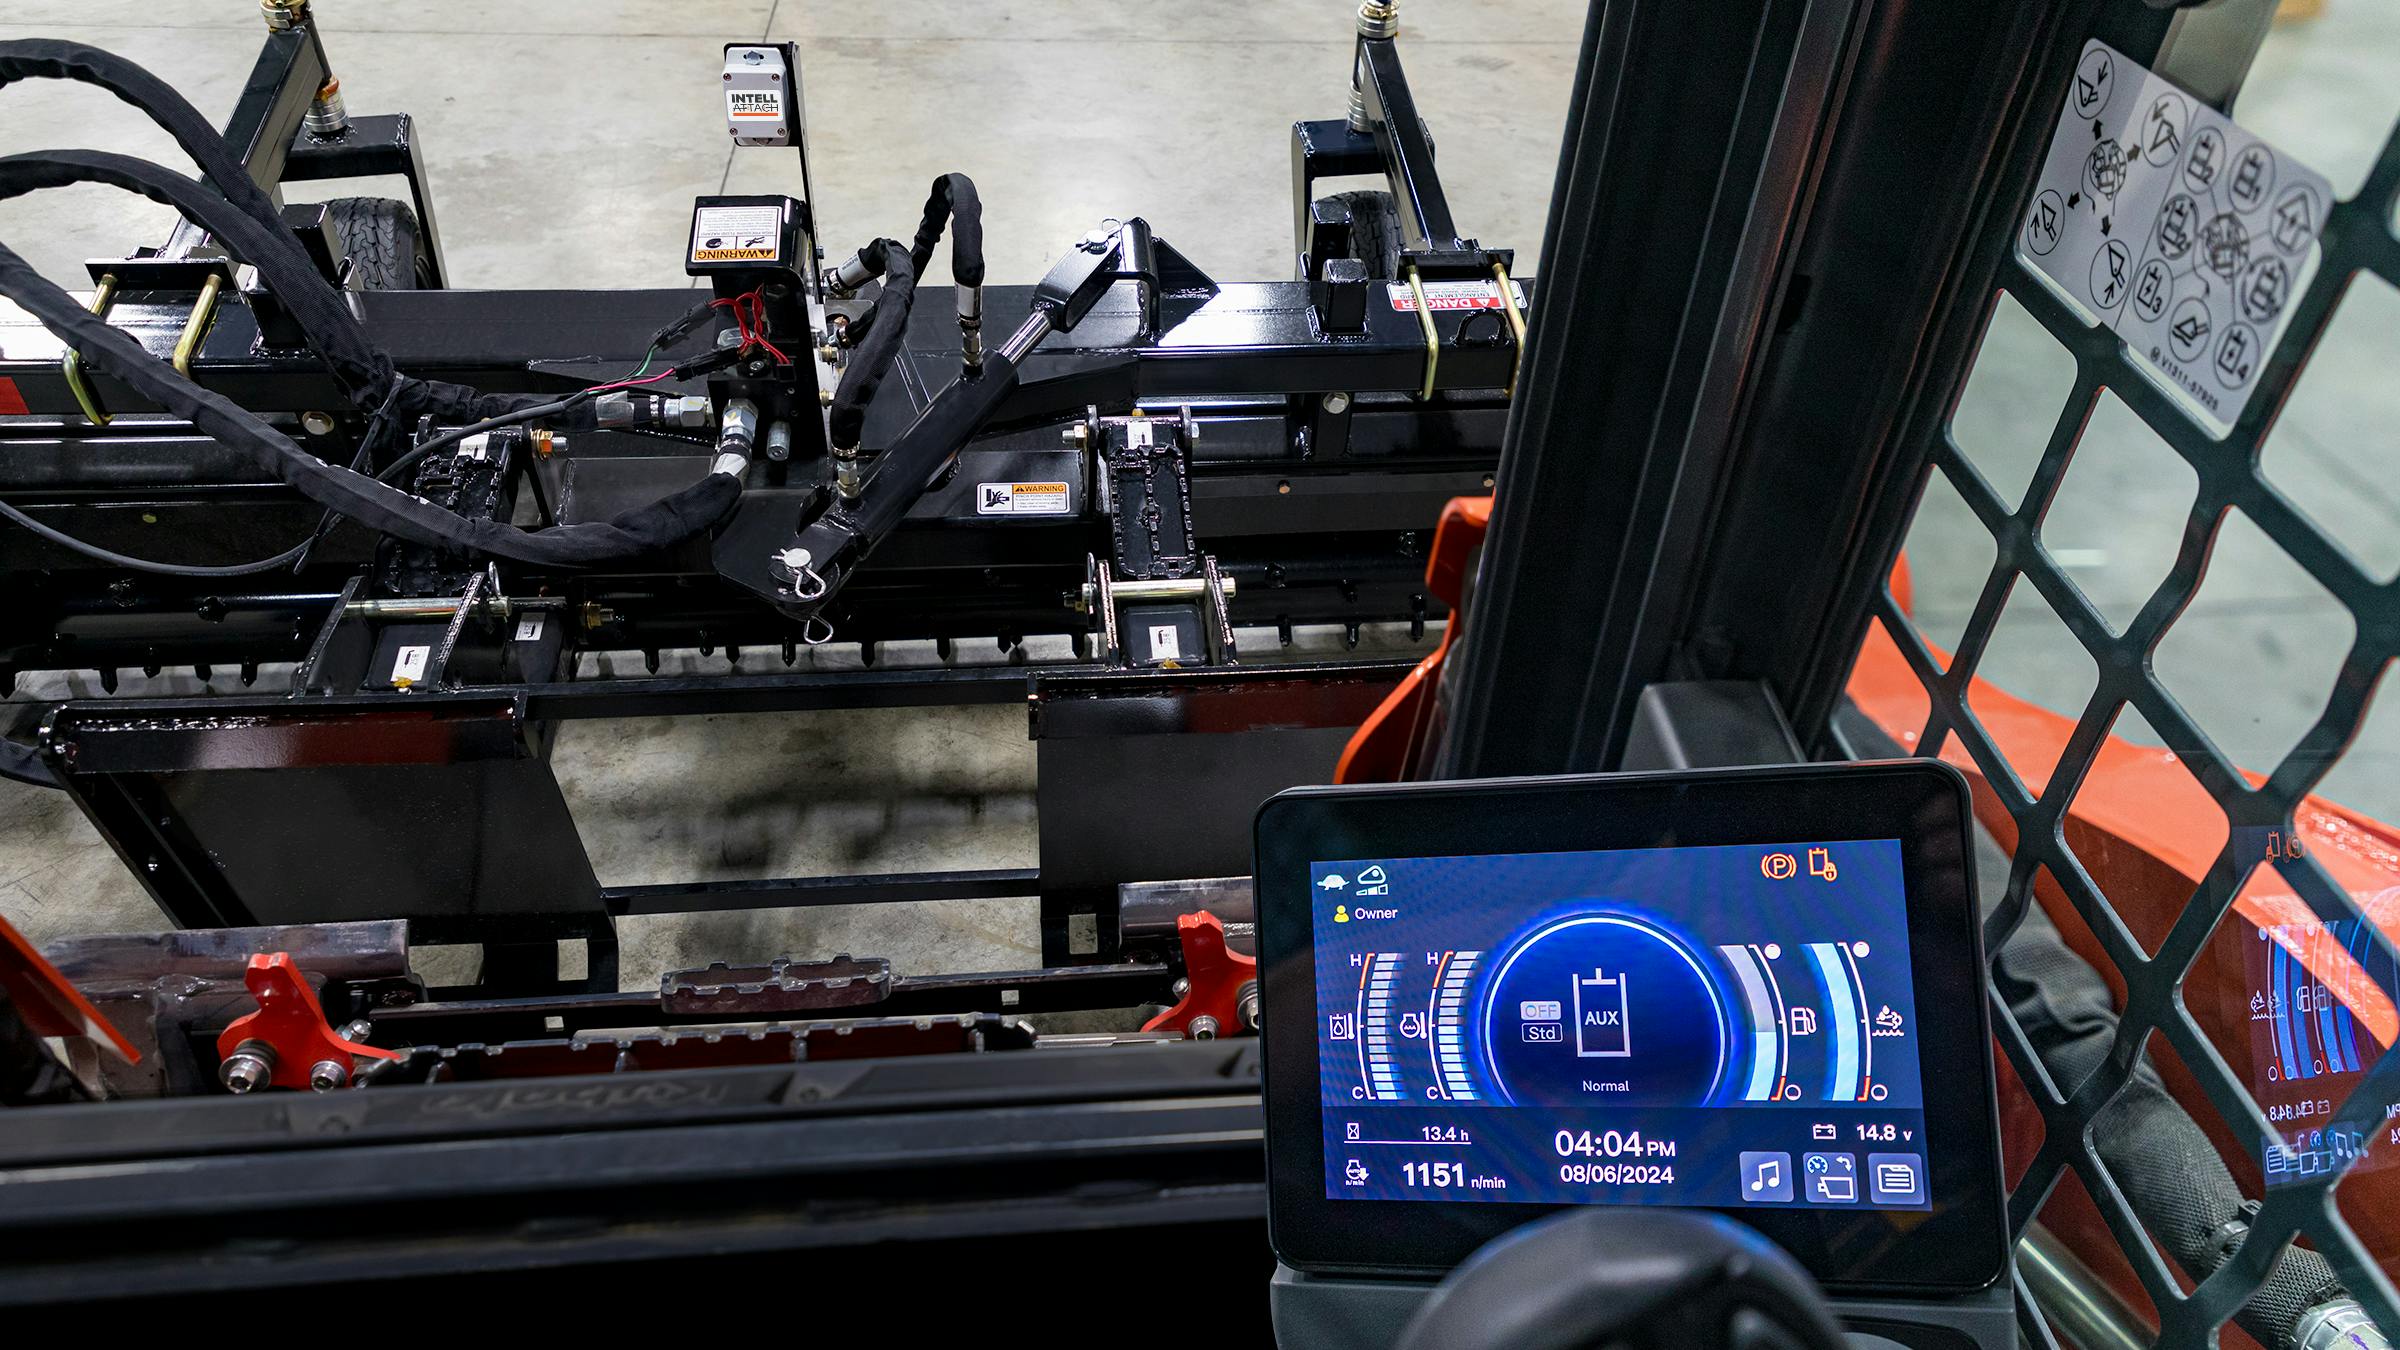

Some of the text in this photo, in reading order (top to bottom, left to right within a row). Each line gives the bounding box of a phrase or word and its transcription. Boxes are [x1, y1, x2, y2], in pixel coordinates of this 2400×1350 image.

[731, 94, 778, 103] INTELL
[733, 104, 778, 112] ATTACH
[698, 250, 758, 259] WARNING
[1400, 299, 1473, 309] DANGR
[1354, 907, 1398, 920] Owner
[1350, 953, 1362, 967] H
[1427, 951, 1439, 965] H
[1525, 1004, 1557, 1018] OFF
[1585, 1011, 1619, 1026] AUX
[1528, 1026, 1556, 1040] Std
[1352, 1086, 1364, 1100] C
[1426, 1086, 1438, 1100] C
[1582, 1080, 1630, 1092] Normal
[1422, 1126, 1469, 1141] 13.4 h
[1856, 1124, 1896, 1141] 14.8
[1555, 1130, 1677, 1157] 04:04 PM
[1402, 1162, 1506, 1190] 1151 n/min
[1560, 1163, 1675, 1185] 08/06/2024
